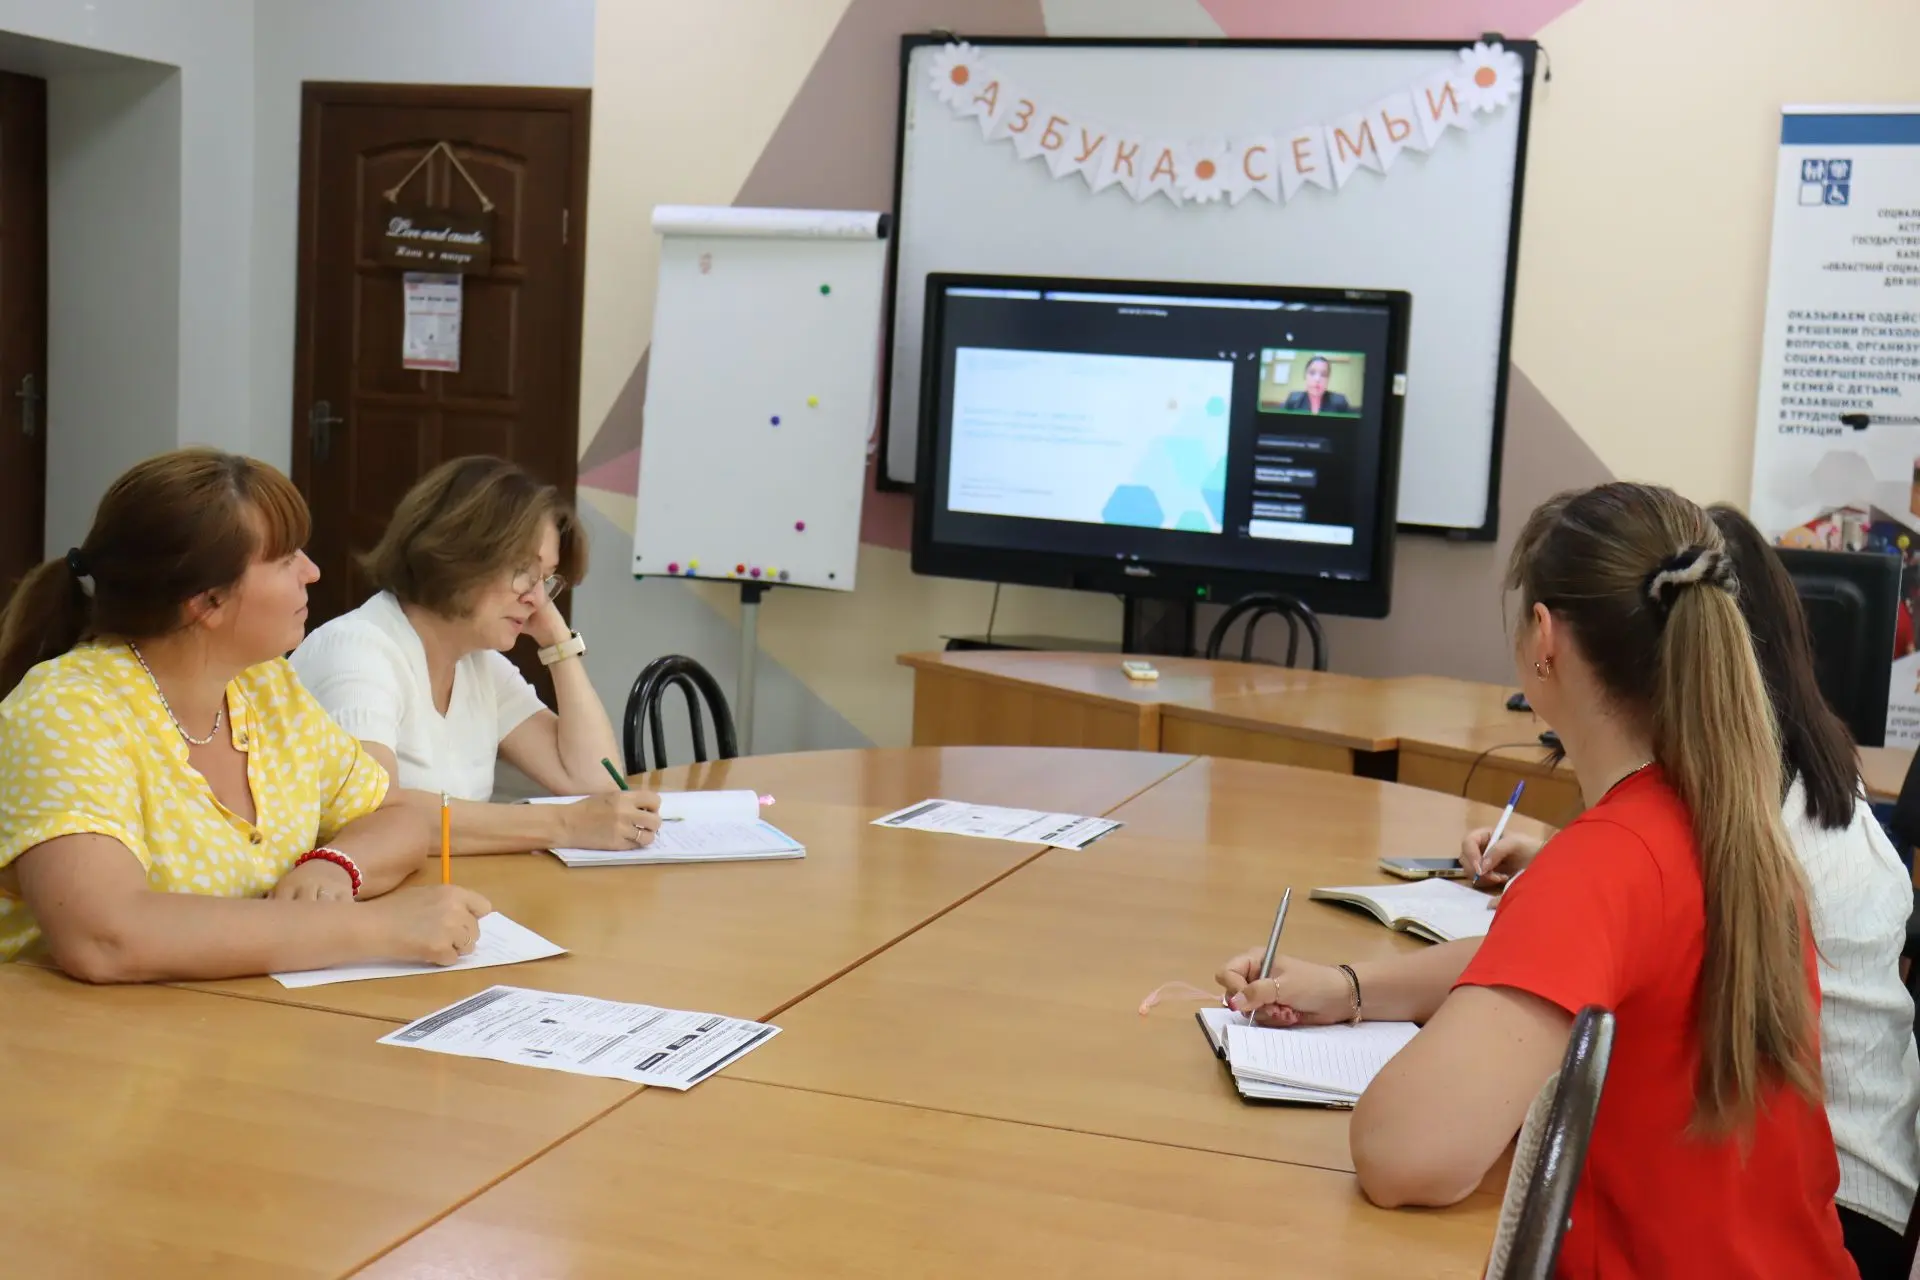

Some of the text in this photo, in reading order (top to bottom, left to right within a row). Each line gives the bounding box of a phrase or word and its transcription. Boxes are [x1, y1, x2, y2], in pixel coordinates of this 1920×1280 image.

[973, 80, 1460, 183] АЗБУКА СЕМЬИ
[1788, 311, 1865, 320] ОКАЗЫВАЕМ
[1798, 325, 1858, 337] РЕШЕНИИ
[1784, 354, 1865, 364] СОЦИАЛЬНОЕ
[1793, 382, 1834, 394] СЕМЕЙ
[1781, 397, 1873, 408] ОКАЗАВШИХСЯ
[1779, 425, 1842, 437] СИТУАЦИИ
